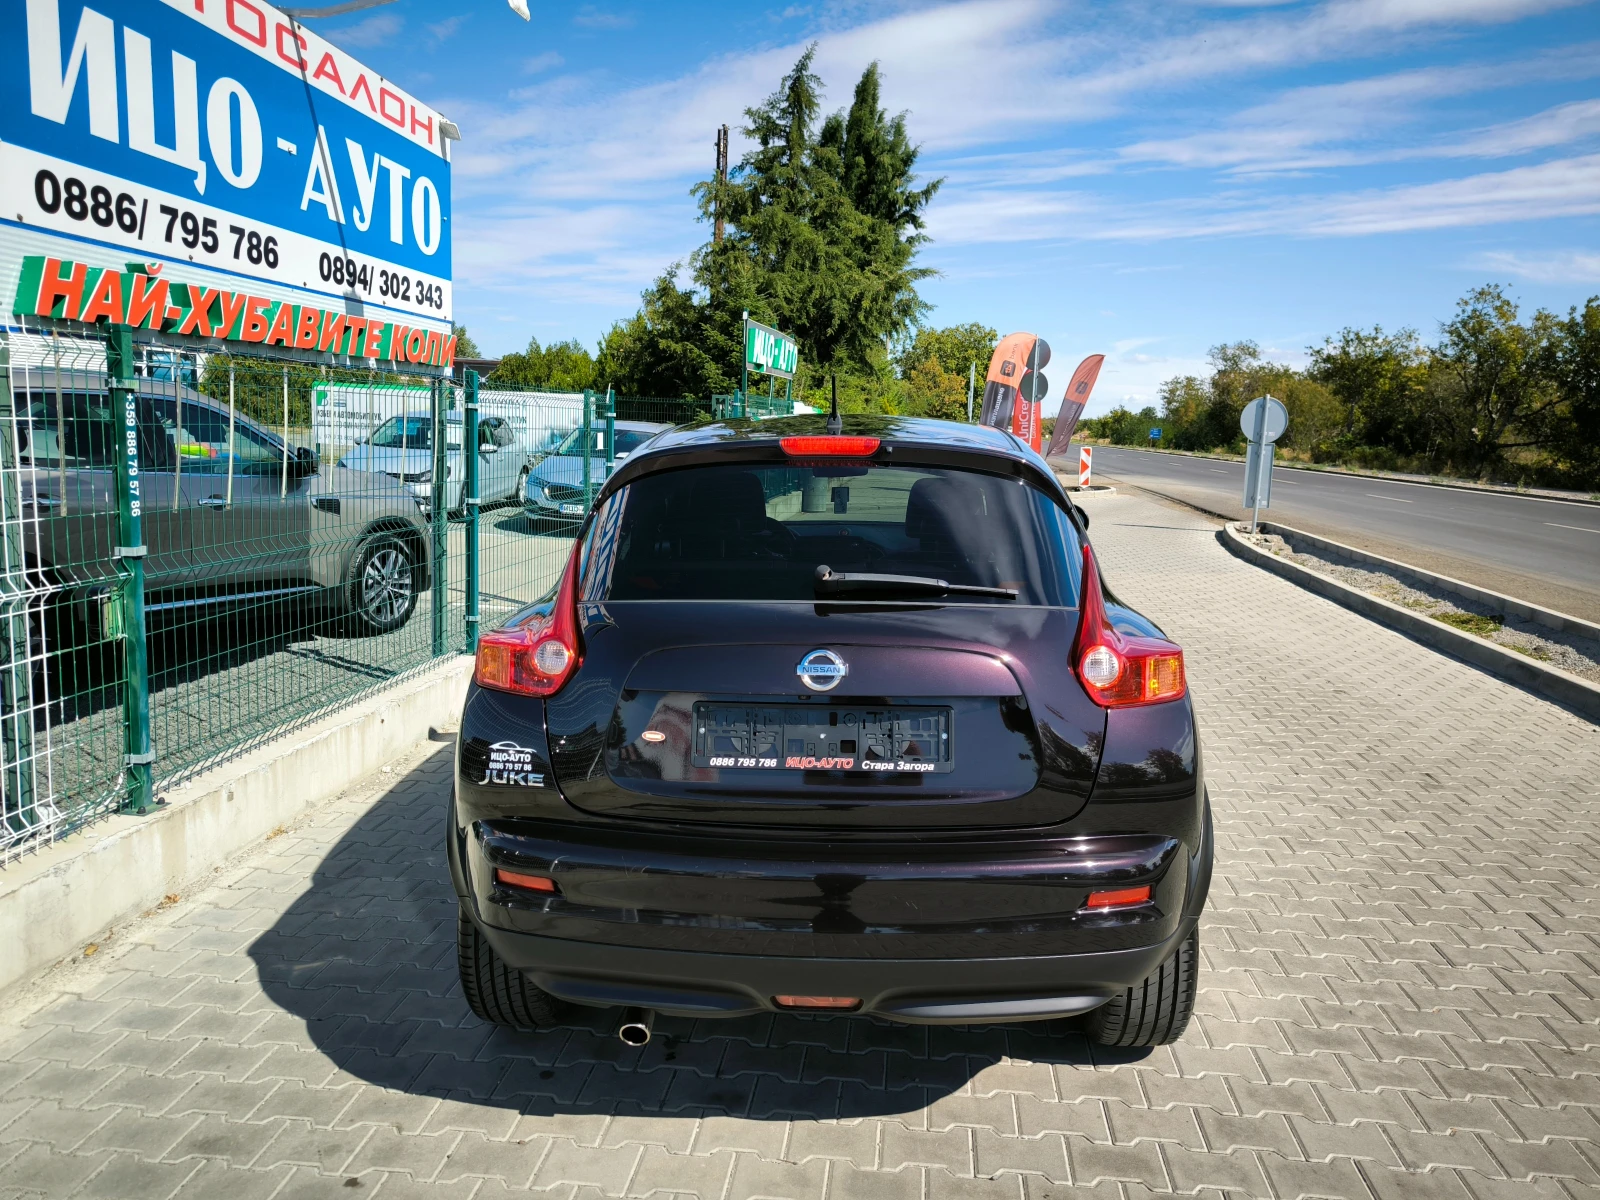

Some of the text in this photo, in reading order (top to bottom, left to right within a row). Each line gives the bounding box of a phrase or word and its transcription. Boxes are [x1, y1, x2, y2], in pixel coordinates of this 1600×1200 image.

[195, 0, 433, 145] ОСАЛОН
[34, 169, 279, 269] 0886/ 795 786
[319, 252, 443, 309] 0894/ 302 343
[35, 256, 457, 368] НАЙ-ХУБАВИТЕ КОЛИ
[1018, 395, 1029, 439] UniCre
[125, 393, 141, 517] +359 886 79 57 86
[802, 666, 840, 674] NISSAN
[478, 769, 545, 787] JUKE
[490, 752, 531, 762] ИЦО-АУТО
[514, 763, 522, 771] 57
[523, 763, 532, 771] 86
[709, 756, 935, 771] 0886 795 786 ИЦО-АУТО Стара Загора
